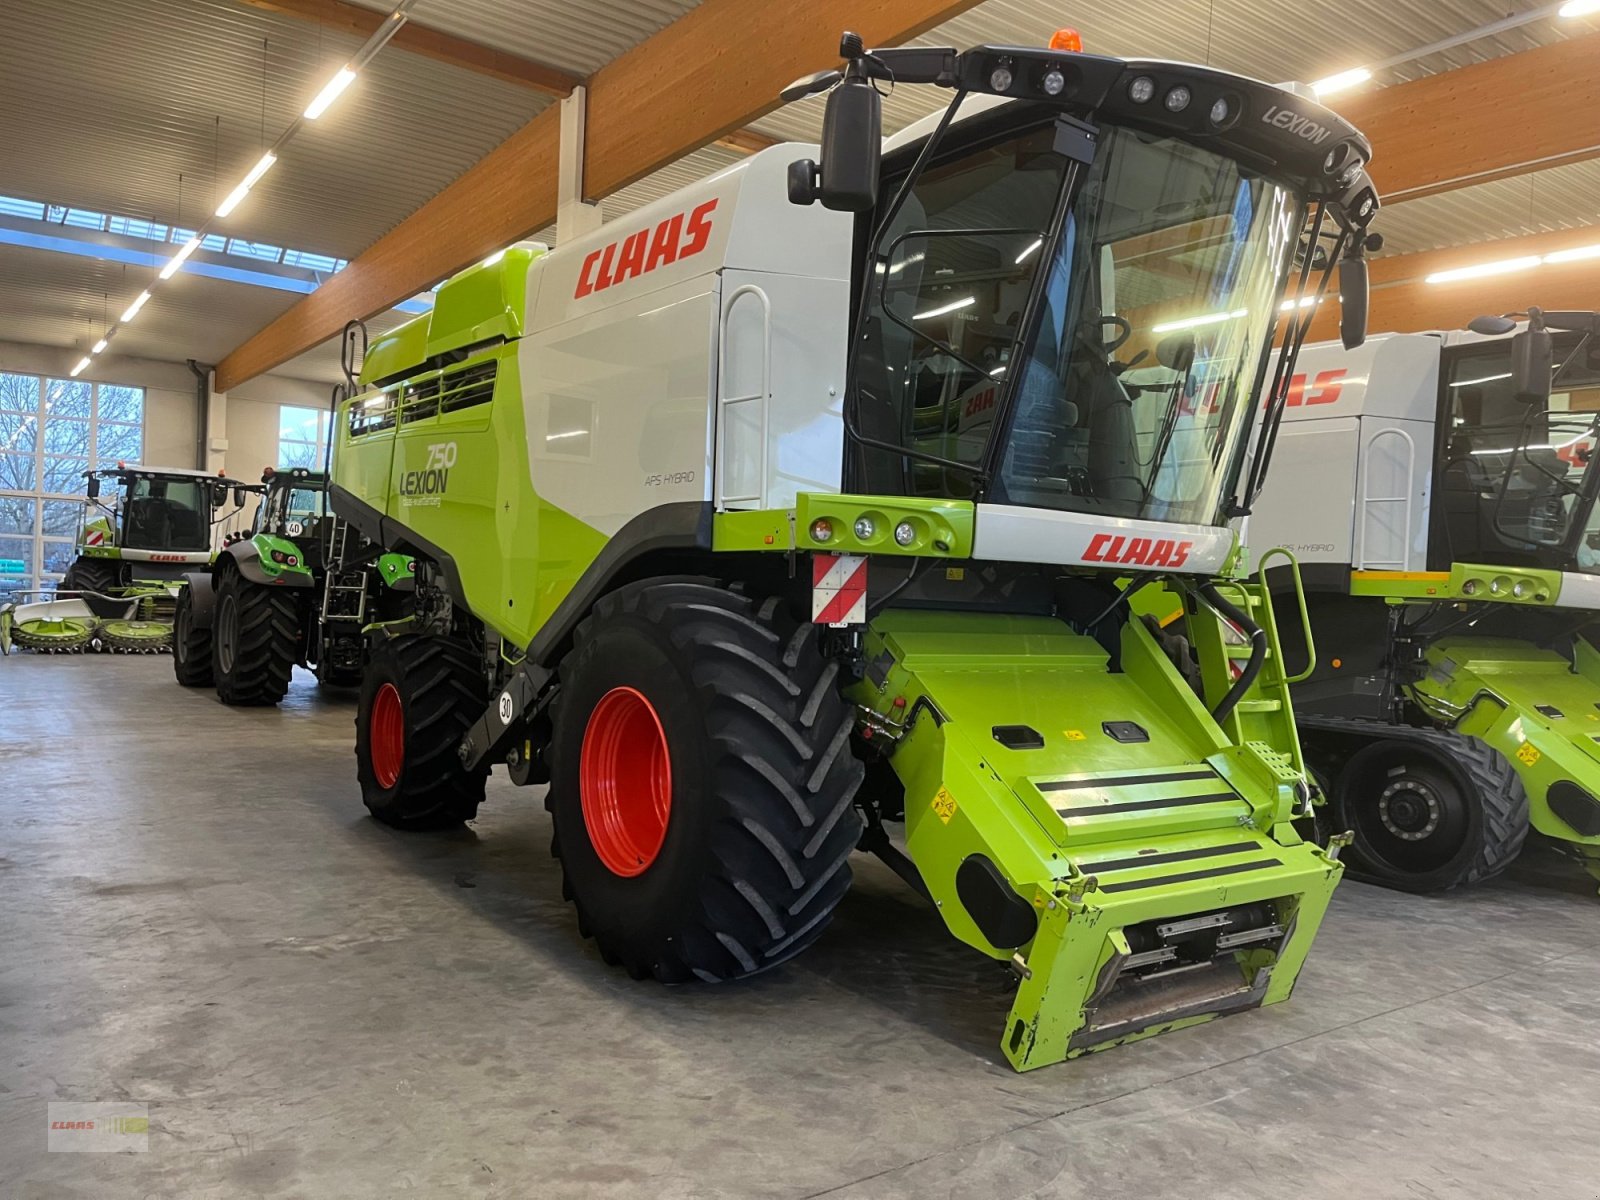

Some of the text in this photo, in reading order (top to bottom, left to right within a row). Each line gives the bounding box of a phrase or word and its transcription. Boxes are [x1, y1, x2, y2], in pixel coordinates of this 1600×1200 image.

[1262, 105, 1332, 145] LEXION
[574, 198, 719, 300] CLAAS
[425, 441, 457, 470] 750
[399, 467, 449, 496] LEXION
[644, 470, 695, 487] APS HYBRID
[289, 523, 300, 534] 40
[1080, 533, 1193, 568] CLAAS
[501, 697, 511, 719] 30
